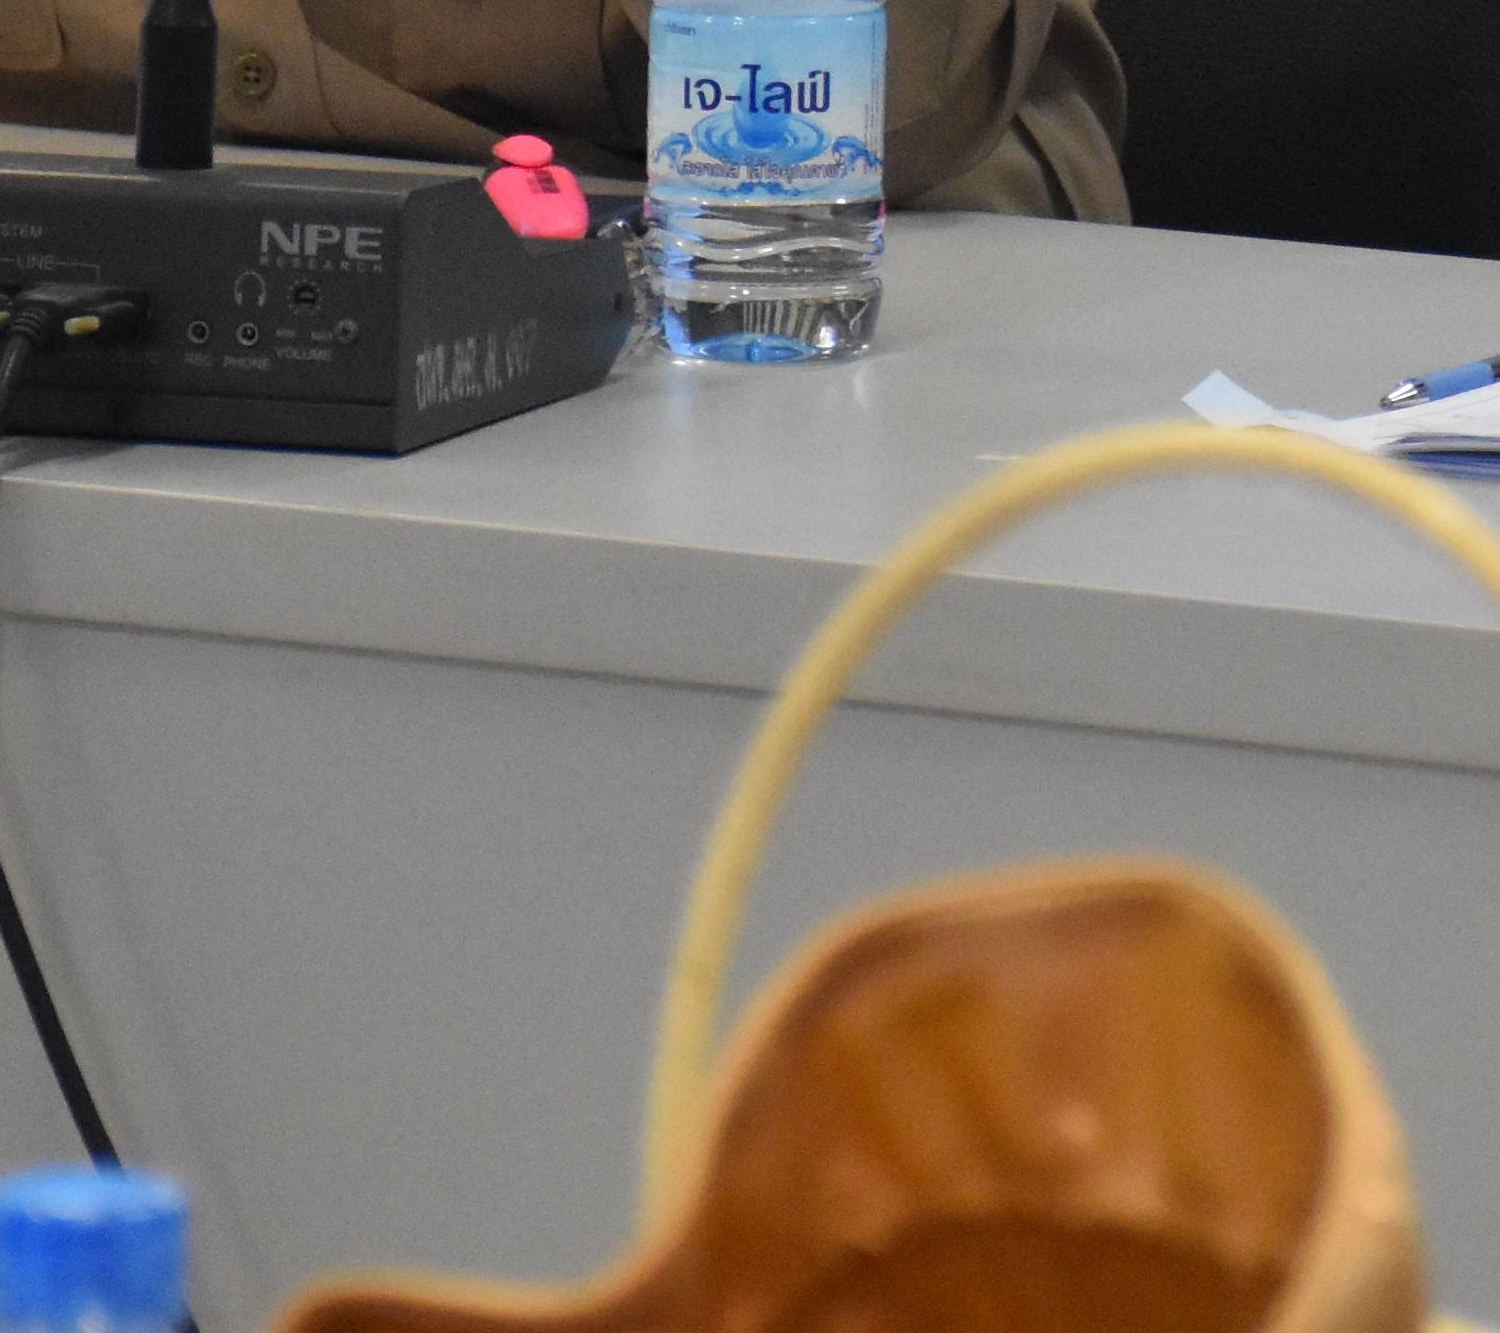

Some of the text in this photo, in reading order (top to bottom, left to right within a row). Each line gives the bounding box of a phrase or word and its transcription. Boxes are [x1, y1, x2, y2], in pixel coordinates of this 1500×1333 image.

[261, 220, 384, 261] NPE
[16, 255, 54, 271] LINE
[259, 255, 384, 273] RESEARCH
[275, 345, 332, 362] VOLUME
